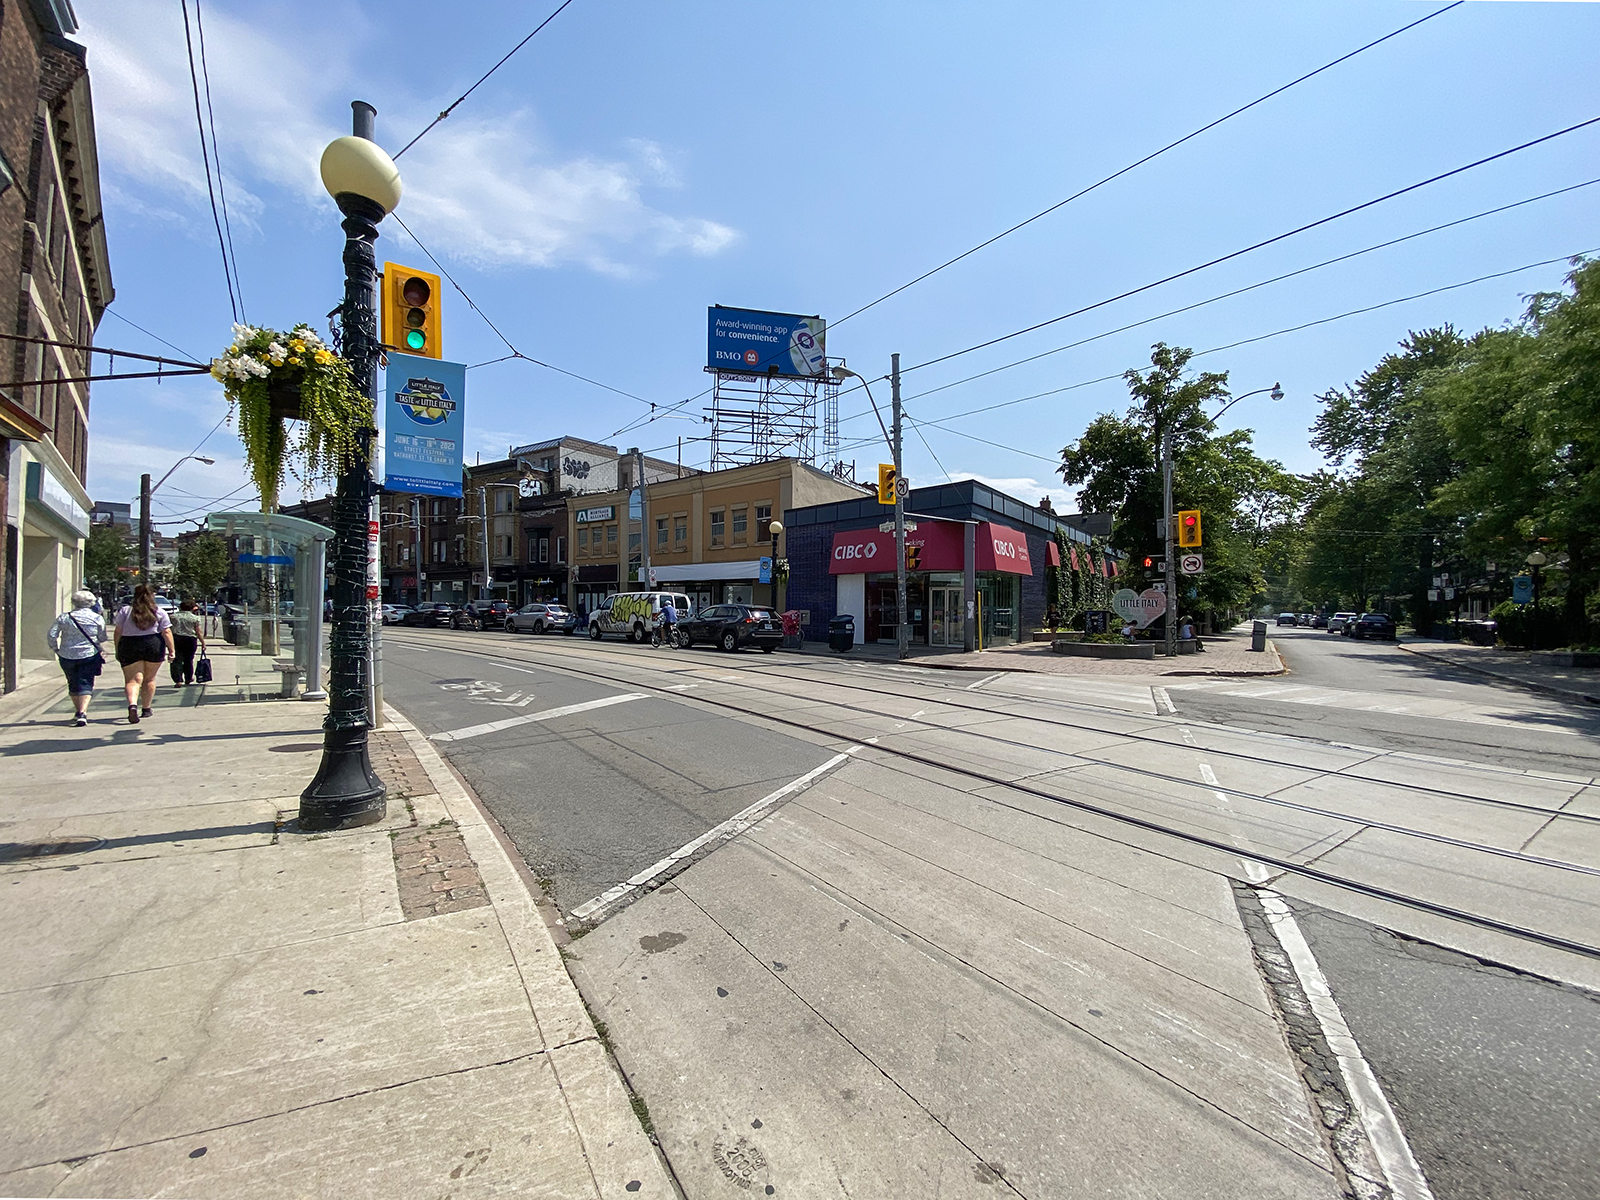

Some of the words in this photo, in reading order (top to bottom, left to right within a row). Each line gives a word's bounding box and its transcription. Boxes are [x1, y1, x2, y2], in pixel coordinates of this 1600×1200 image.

[715, 318, 772, 334] Award-winning
[773, 326, 788, 336] app
[715, 327, 727, 338] for
[728, 331, 780, 344] convenience.
[715, 350, 742, 361] BMO
[411, 381, 428, 389] LITTLE
[398, 394, 415, 404] TASTE
[420, 398, 438, 408] LITTLE
[438, 400, 453, 409] ITALY
[394, 435, 410, 445] JUNE
[412, 438, 418, 446] 16
[440, 441, 455, 451] 2023
[423, 449, 445, 457] FESTIVAL
[834, 543, 864, 561] CIBC
[994, 539, 1010, 557] CIBC
[1120, 599, 1139, 608] LITTLE
[1141, 599, 1159, 608] ITALY
[726, 1147, 757, 1177] 2005
